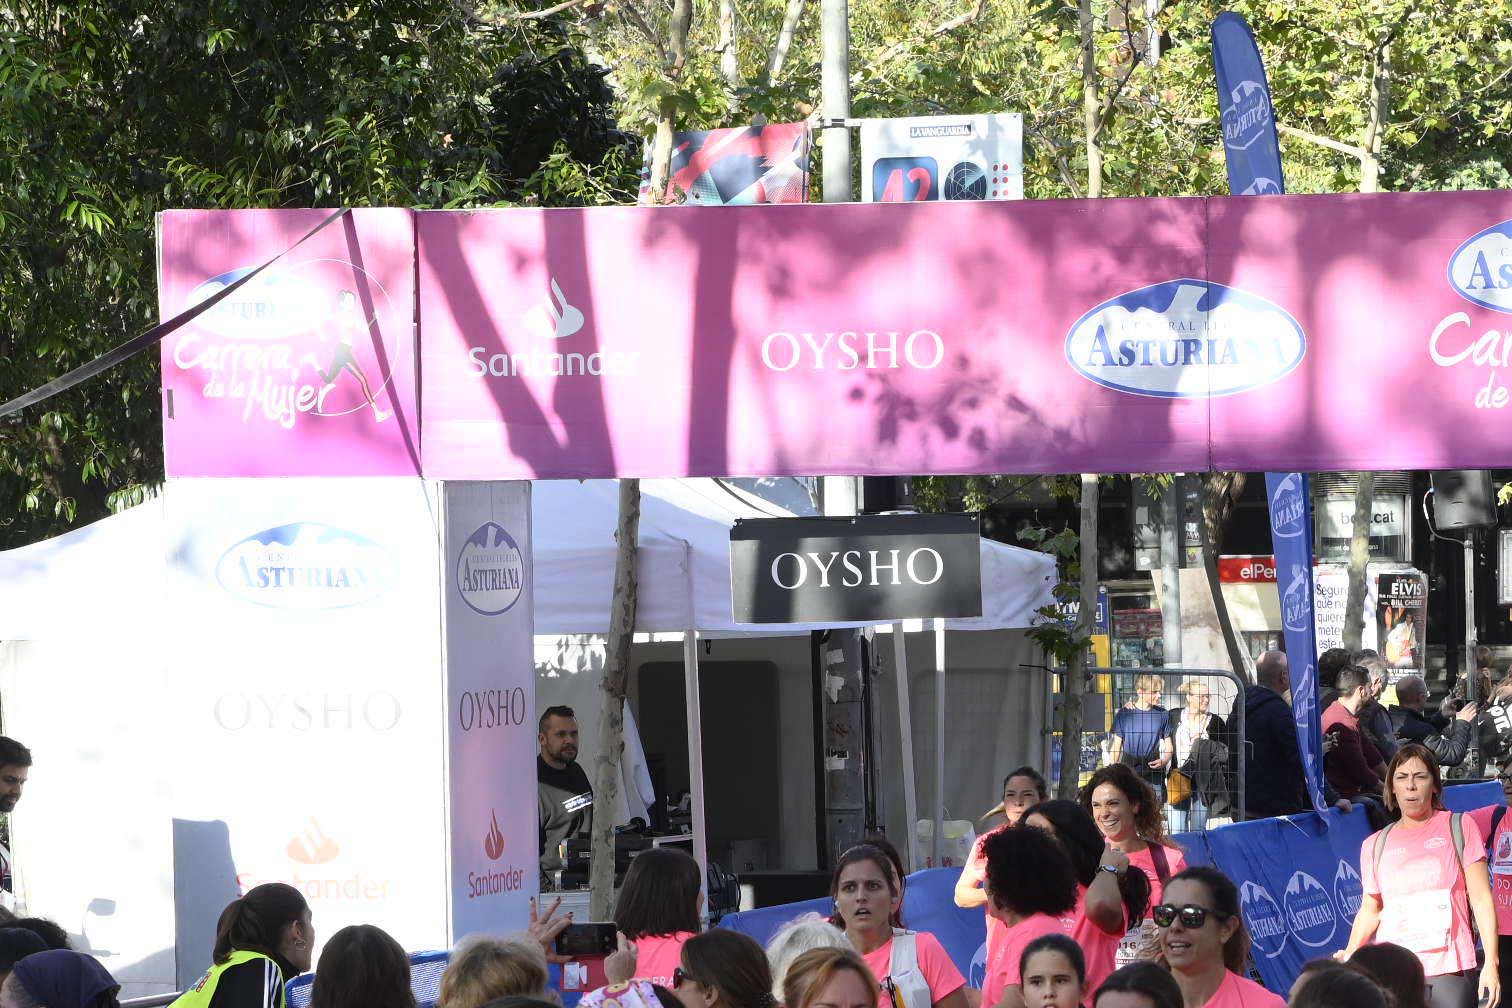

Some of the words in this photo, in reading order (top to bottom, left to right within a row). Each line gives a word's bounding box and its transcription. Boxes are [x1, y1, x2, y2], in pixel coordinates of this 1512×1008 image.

[468, 344, 640, 380] Santander
[761, 329, 945, 372] OYSHO
[1474, 370, 1510, 409] de
[462, 557, 520, 592] ASTURIANA
[771, 547, 944, 590] OYSHO
[1316, 583, 1348, 598] Segur
[1391, 582, 1423, 596] ELVIS
[1318, 626, 1343, 636] mete
[460, 686, 526, 732] OYSHO
[469, 865, 524, 900] Santander
